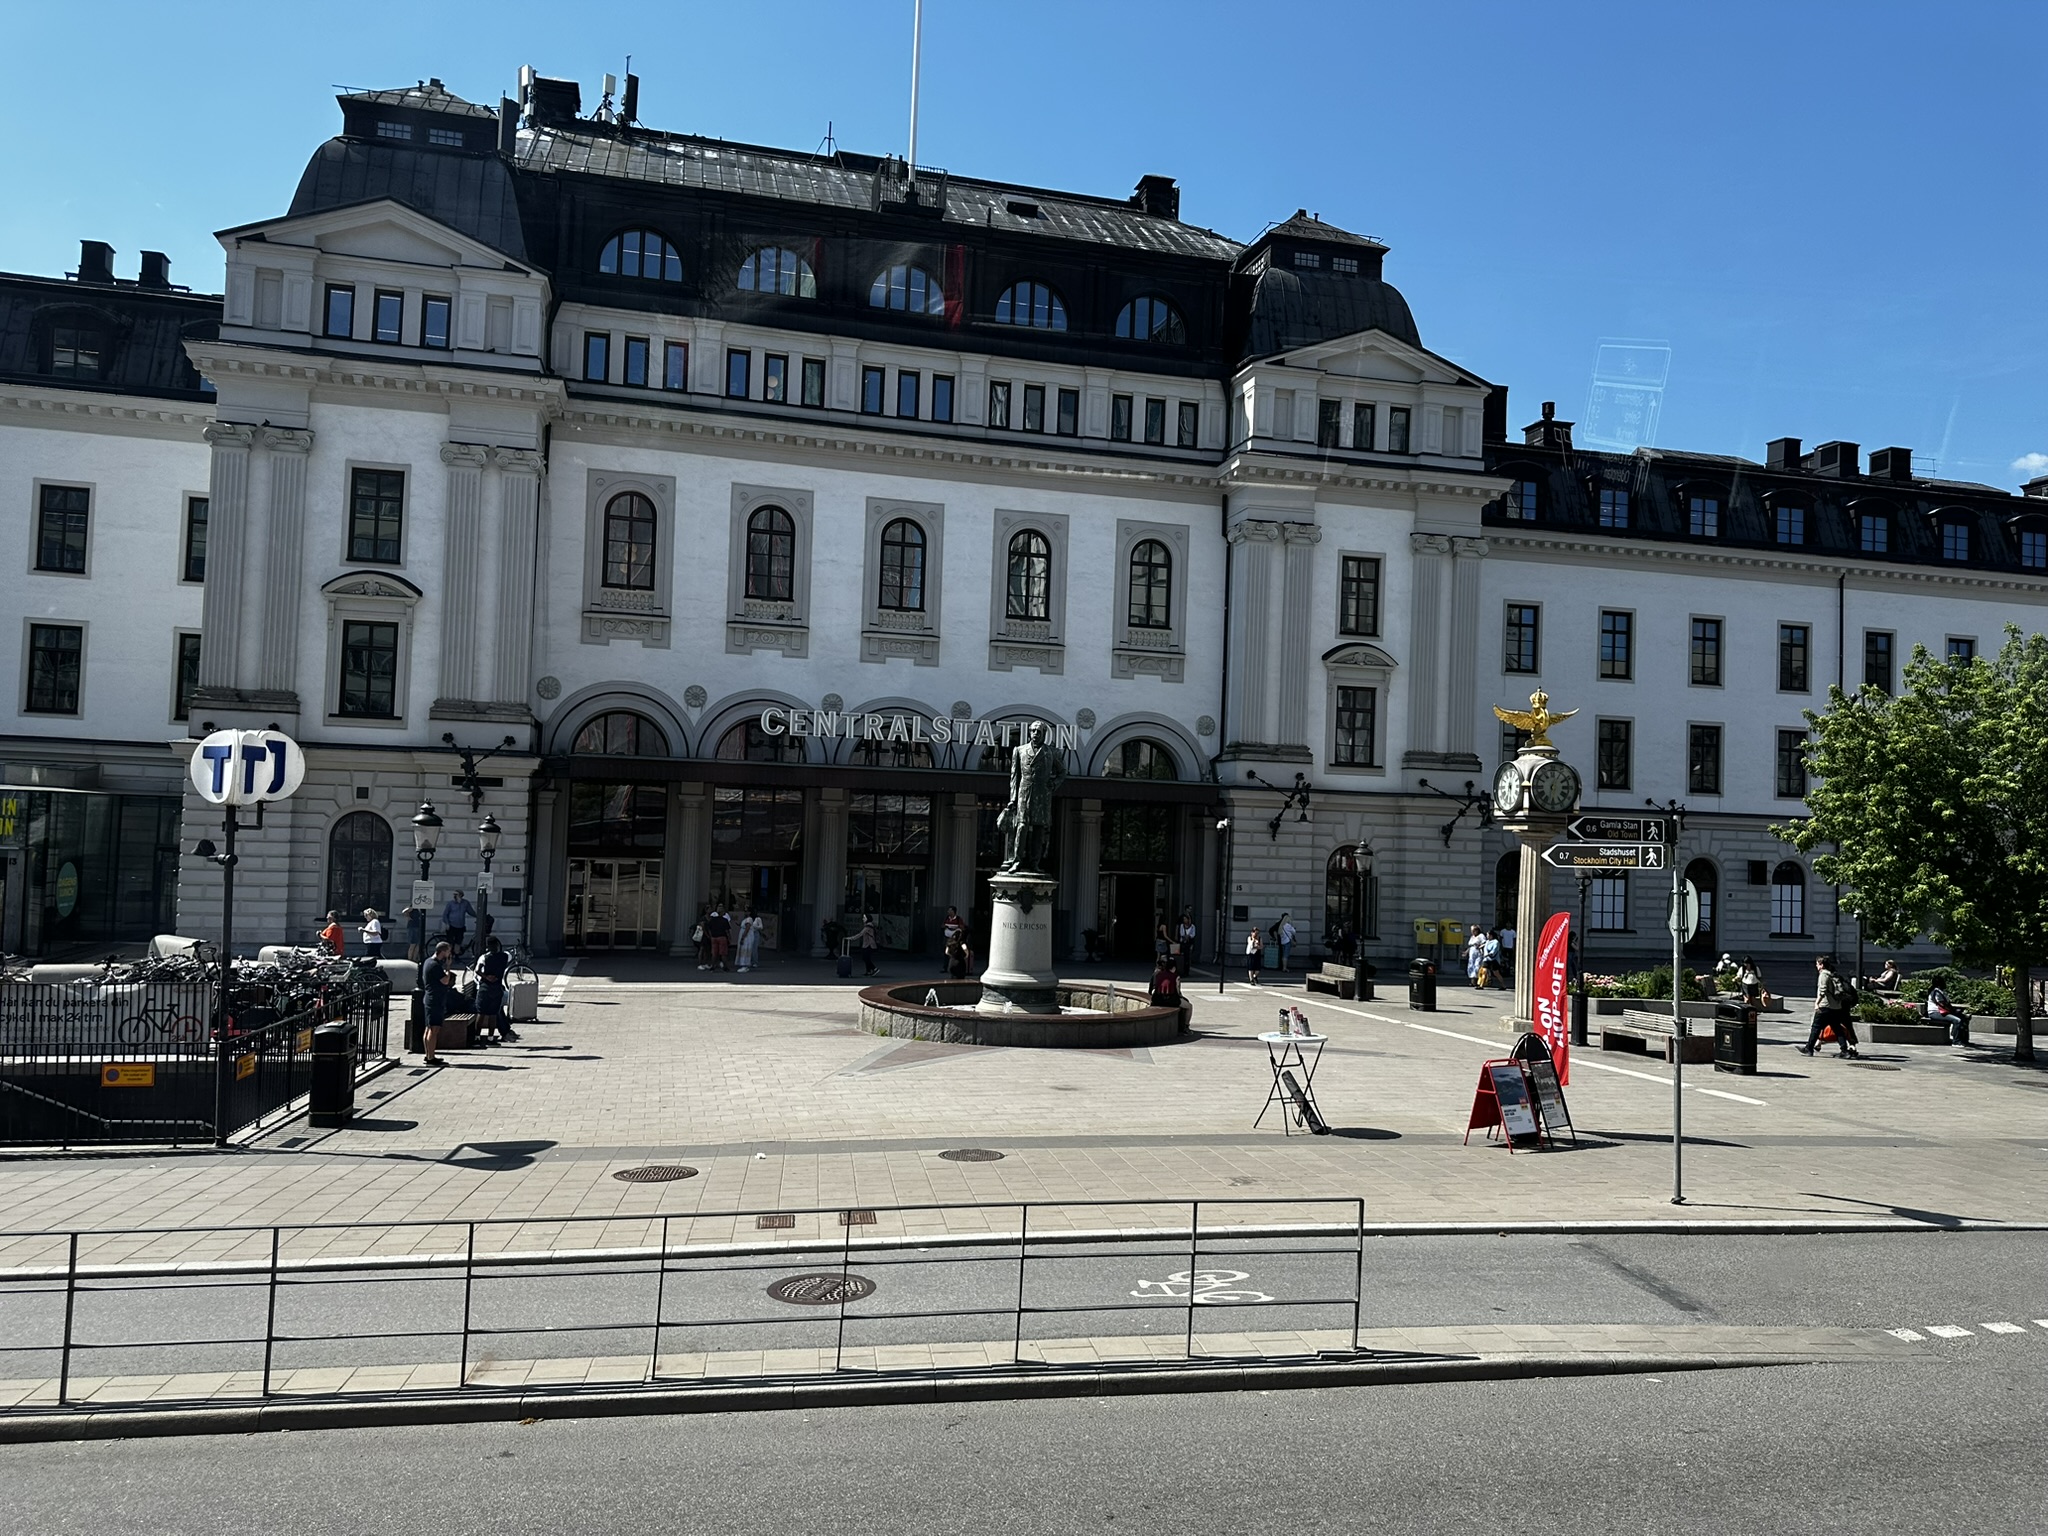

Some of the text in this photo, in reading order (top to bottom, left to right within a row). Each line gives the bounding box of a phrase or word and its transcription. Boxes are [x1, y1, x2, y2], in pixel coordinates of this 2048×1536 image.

[202, 745, 232, 794] T
[242, 745, 267, 795] T
[1600, 820, 1638, 830] Gamla Stan
[1607, 830, 1638, 839] Old Town
[1599, 847, 1637, 857] Stadshuset
[1573, 856, 1607, 865] Stockholm
[1608, 857, 1622, 866] City
[1002, 921, 1048, 931] NILS ERICSON
[1552, 957, 1565, 1049] HOP-OFF
